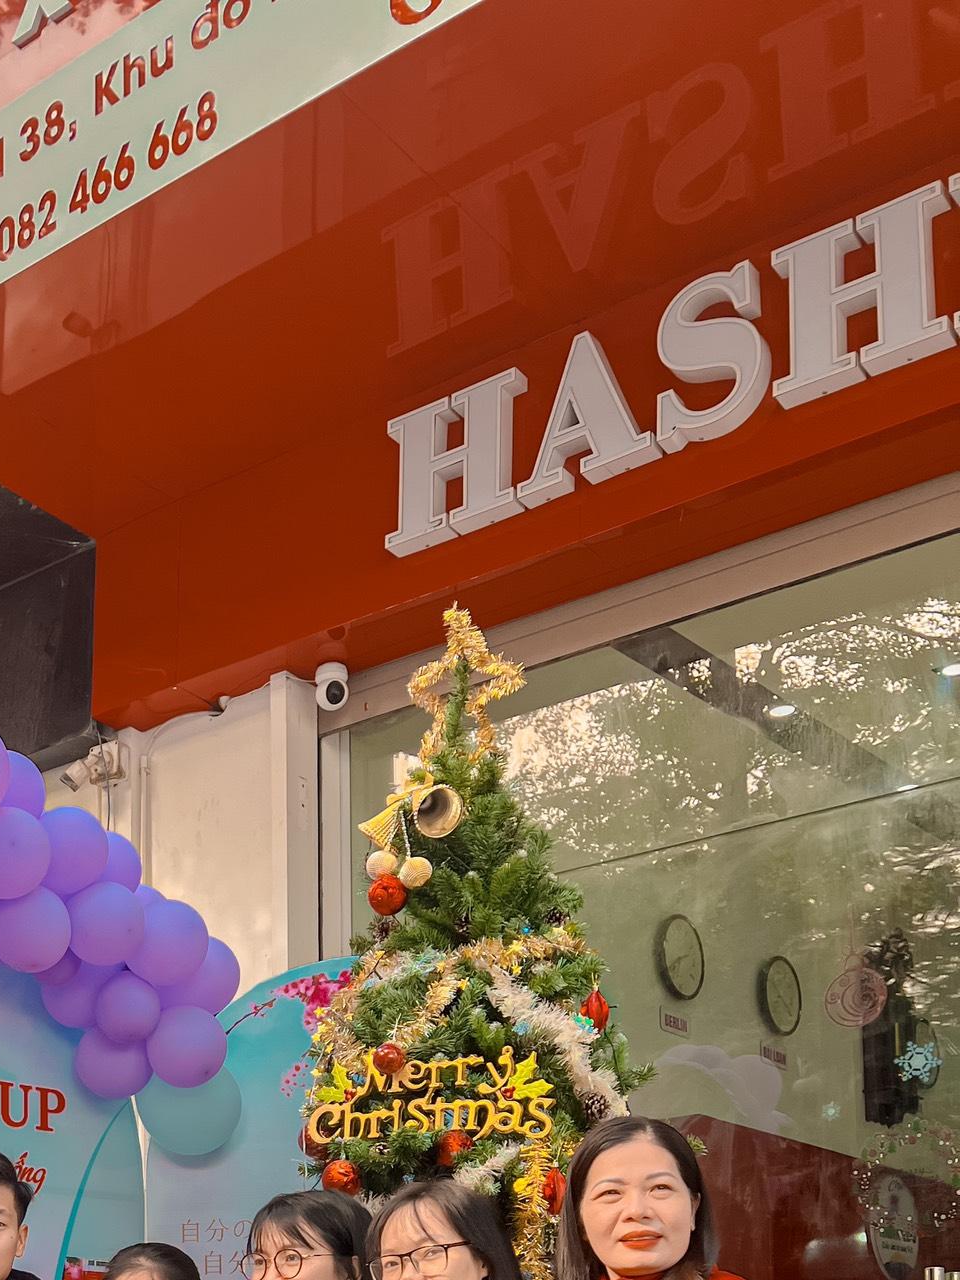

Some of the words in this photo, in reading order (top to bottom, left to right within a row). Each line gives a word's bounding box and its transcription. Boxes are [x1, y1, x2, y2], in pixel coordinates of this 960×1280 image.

[19, 99, 77, 164] 38,
[94, 34, 174, 116] Khu
[69, 142, 135, 214] 466
[148, 91, 218, 171] 668
[385, 172, 960, 558] HASH
[307, 1089, 557, 1145] Christmas
[354, 1046, 516, 1096] Merry
